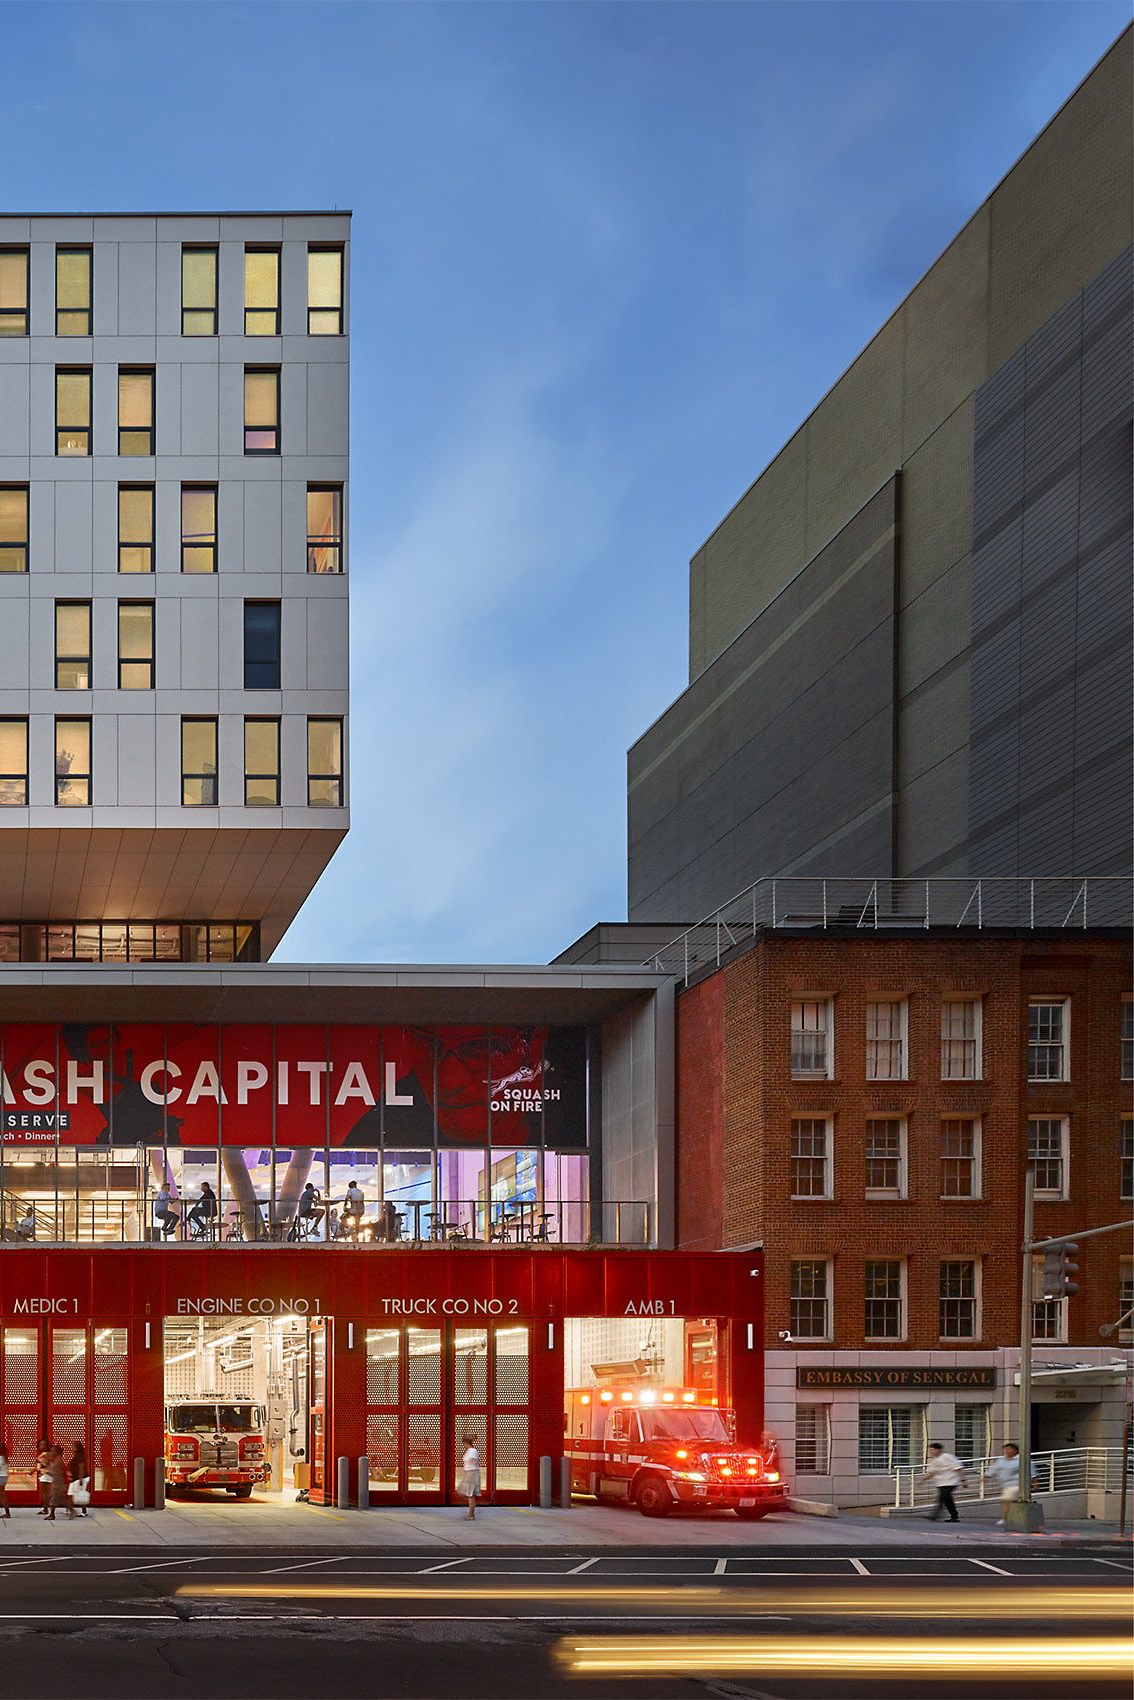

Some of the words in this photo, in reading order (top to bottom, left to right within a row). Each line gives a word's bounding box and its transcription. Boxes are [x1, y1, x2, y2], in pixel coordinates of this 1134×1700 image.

[140, 1060, 414, 1106] CAPITAL
[503, 1089, 561, 1101] SQUASH
[490, 1101, 511, 1112] ON
[513, 1101, 543, 1112] FIRE
[7, 1115, 68, 1127] SERVE
[25, 1132, 56, 1141] Dinner
[13, 1298, 68, 1314] MEDIC
[73, 1298, 79, 1314] 1
[177, 1298, 243, 1314] ENGINE
[247, 1298, 275, 1314] CO
[280, 1298, 309, 1314] NO
[314, 1298, 321, 1314] 1
[381, 1298, 437, 1314] TRUCK
[442, 1298, 469, 1315] CO
[473, 1298, 503, 1315] NO
[508, 1298, 518, 1314] 2
[624, 1299, 665, 1315] AMB
[669, 1300, 675, 1315] 1
[806, 1371, 884, 1383] EMBASSY
[887, 1371, 910, 1383] OF
[913, 1371, 991, 1384] SENEGAL
